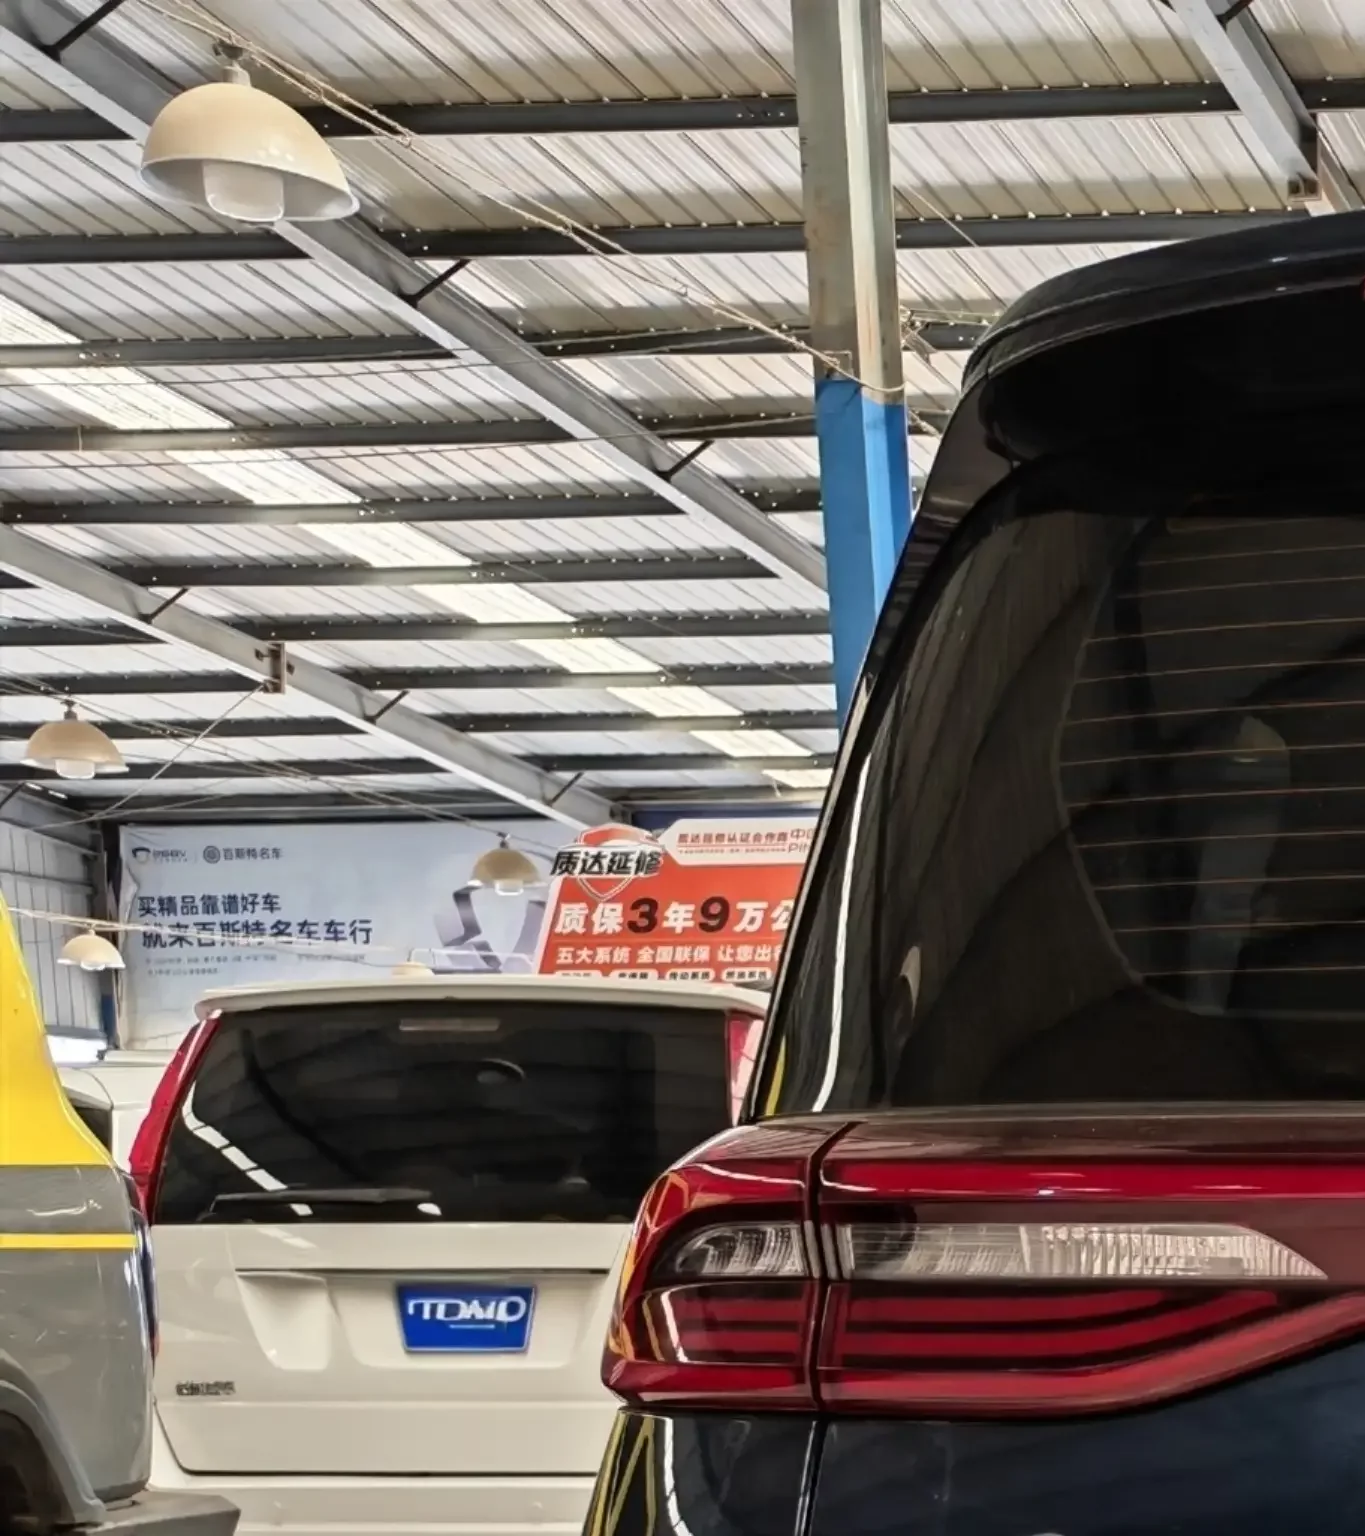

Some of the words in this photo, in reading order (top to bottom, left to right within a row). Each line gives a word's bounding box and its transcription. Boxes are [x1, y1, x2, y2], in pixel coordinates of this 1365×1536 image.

[550, 850, 661, 877] 质达延修
[138, 893, 282, 918] 买精品靠谱好车
[556, 946, 631, 965] 五大系统
[636, 945, 711, 964] 全国联保
